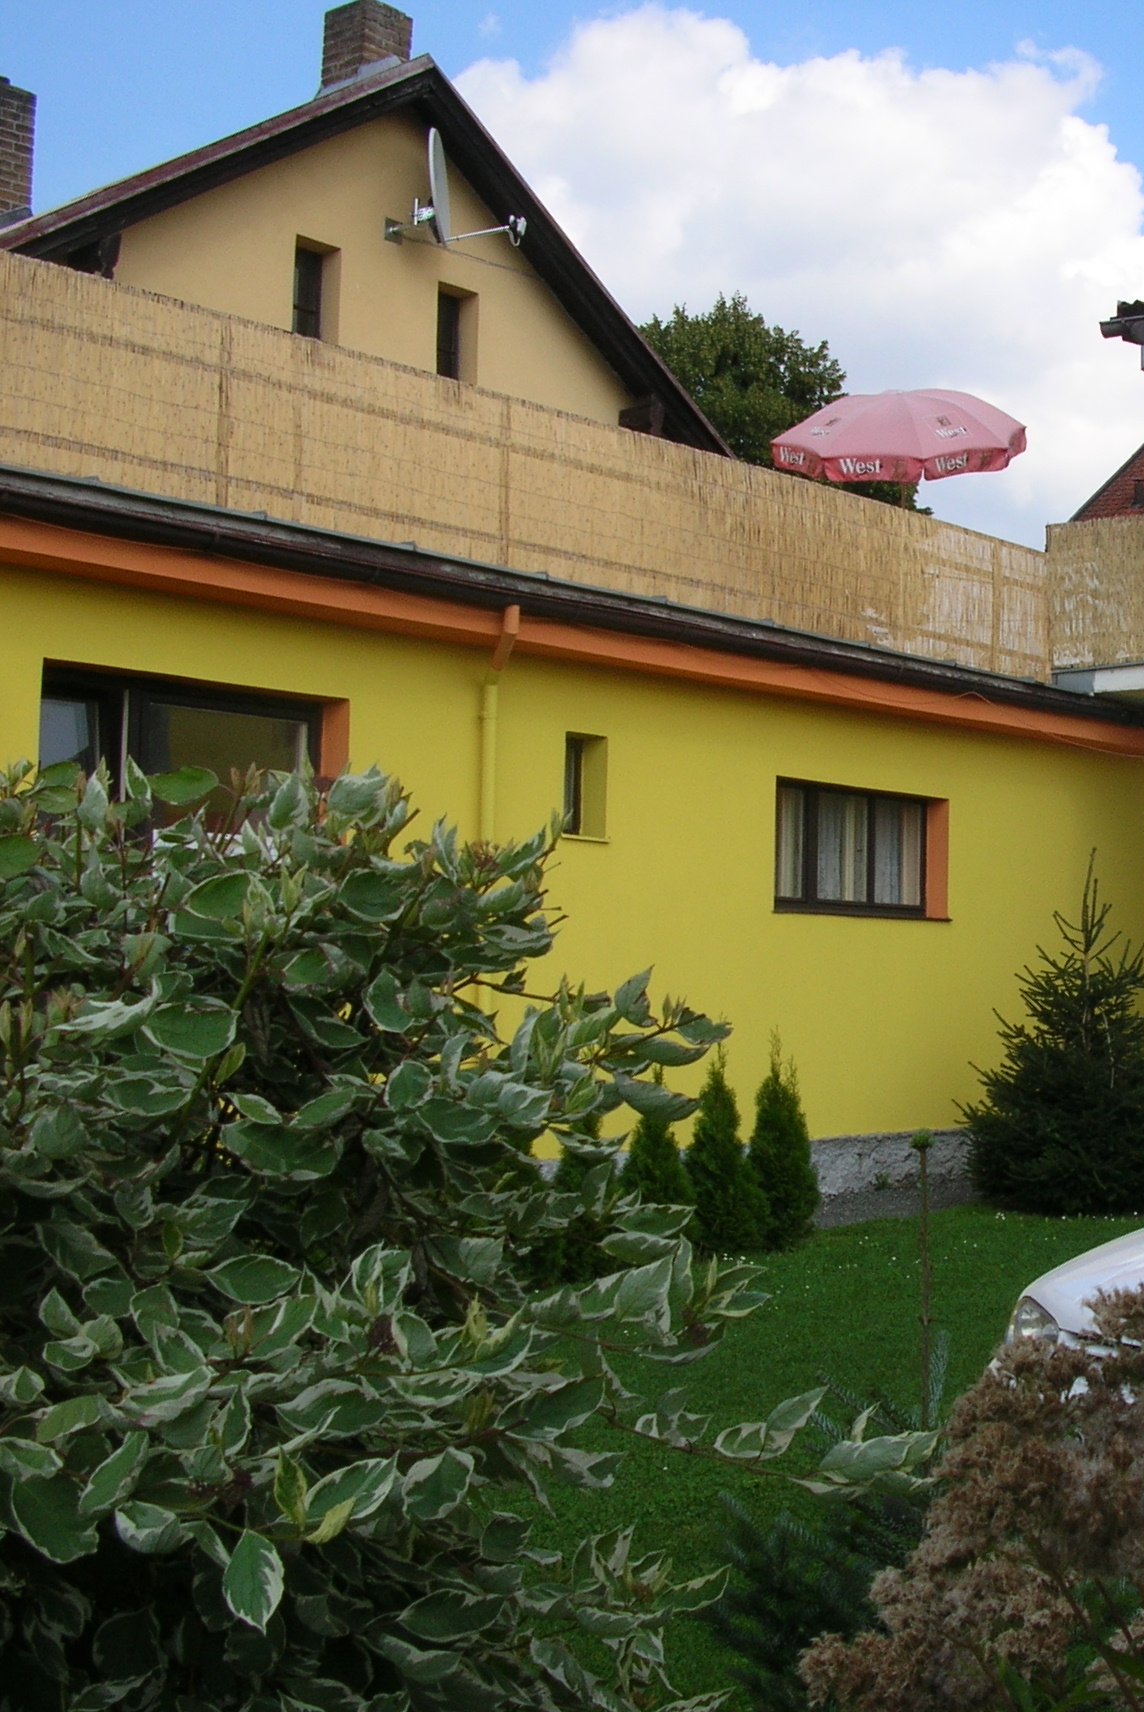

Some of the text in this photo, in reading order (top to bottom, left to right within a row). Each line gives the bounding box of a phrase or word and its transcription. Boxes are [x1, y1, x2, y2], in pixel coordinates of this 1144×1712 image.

[779, 446, 806, 466] West
[934, 452, 969, 473] West
[839, 458, 882, 475] West
